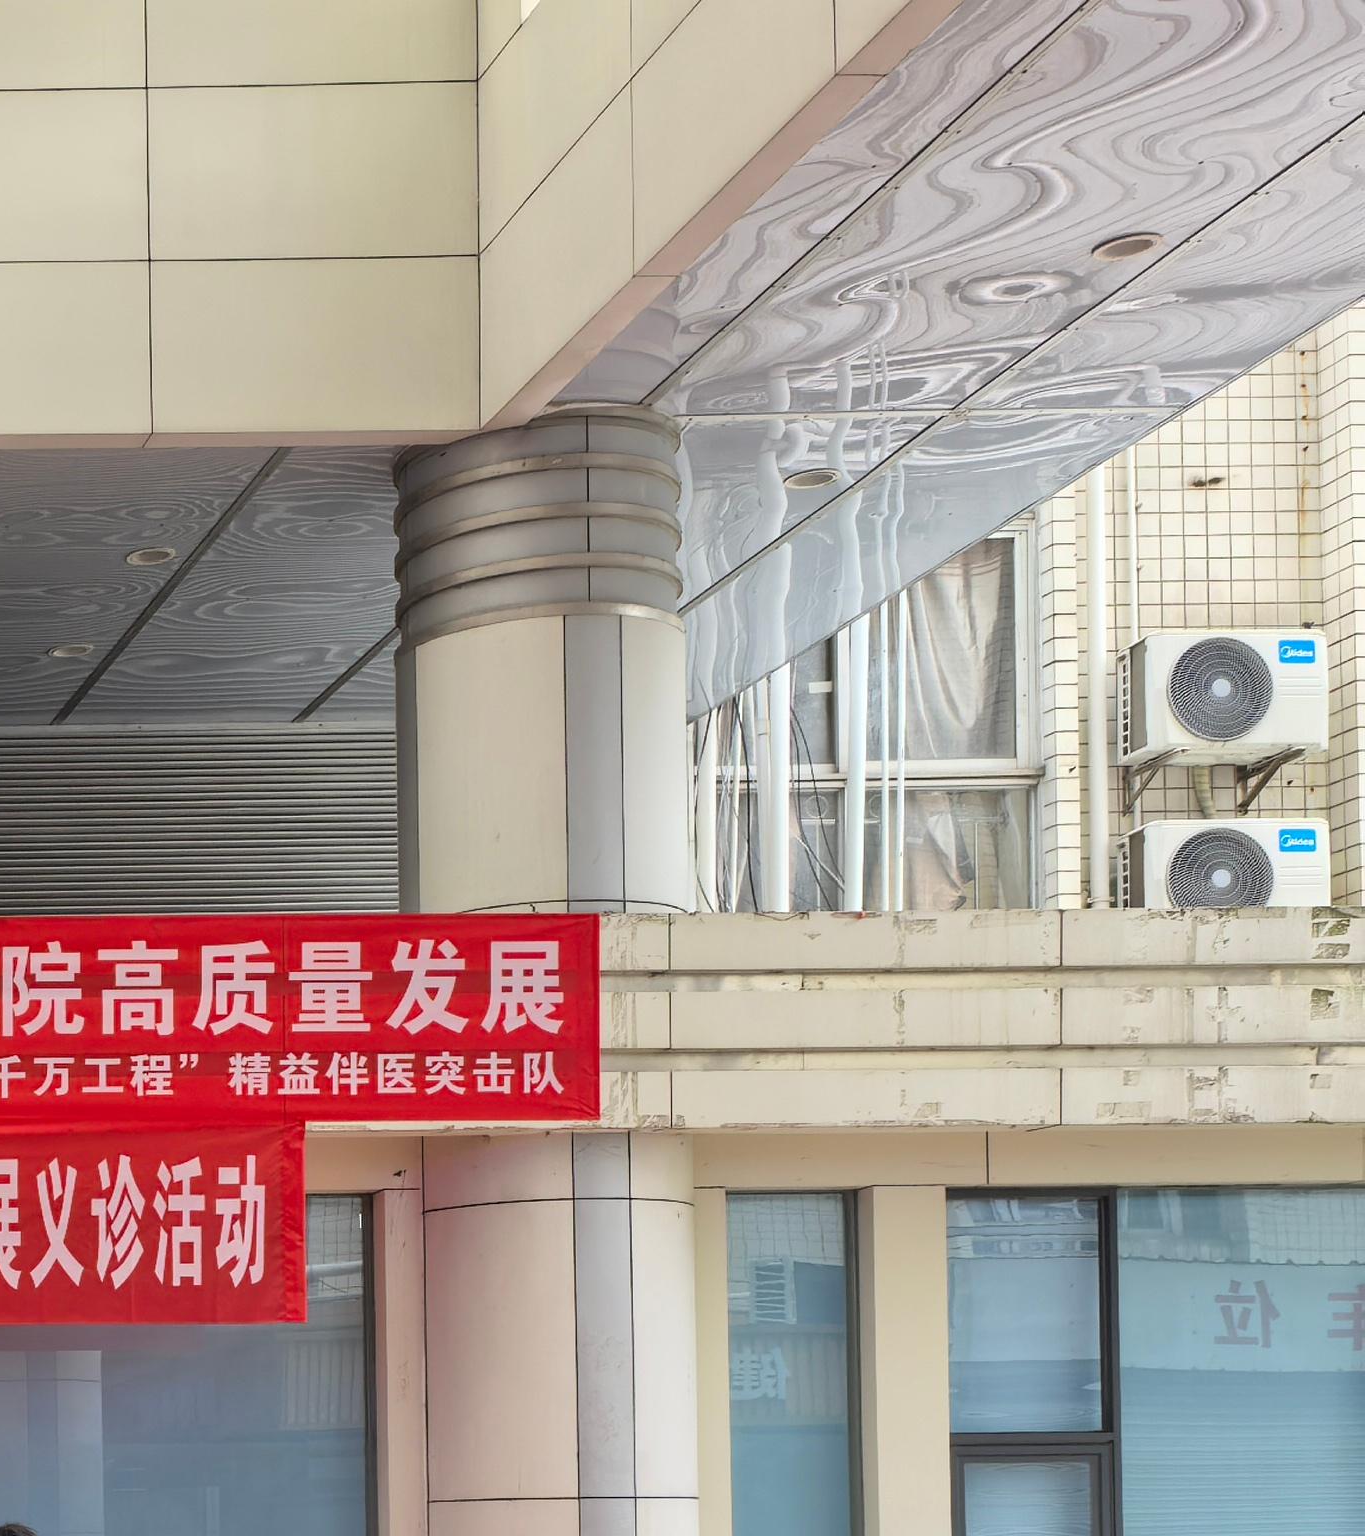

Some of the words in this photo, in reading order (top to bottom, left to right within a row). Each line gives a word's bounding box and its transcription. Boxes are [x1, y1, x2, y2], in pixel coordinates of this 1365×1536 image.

[228, 1050, 566, 1099] 精益伴医突击队
